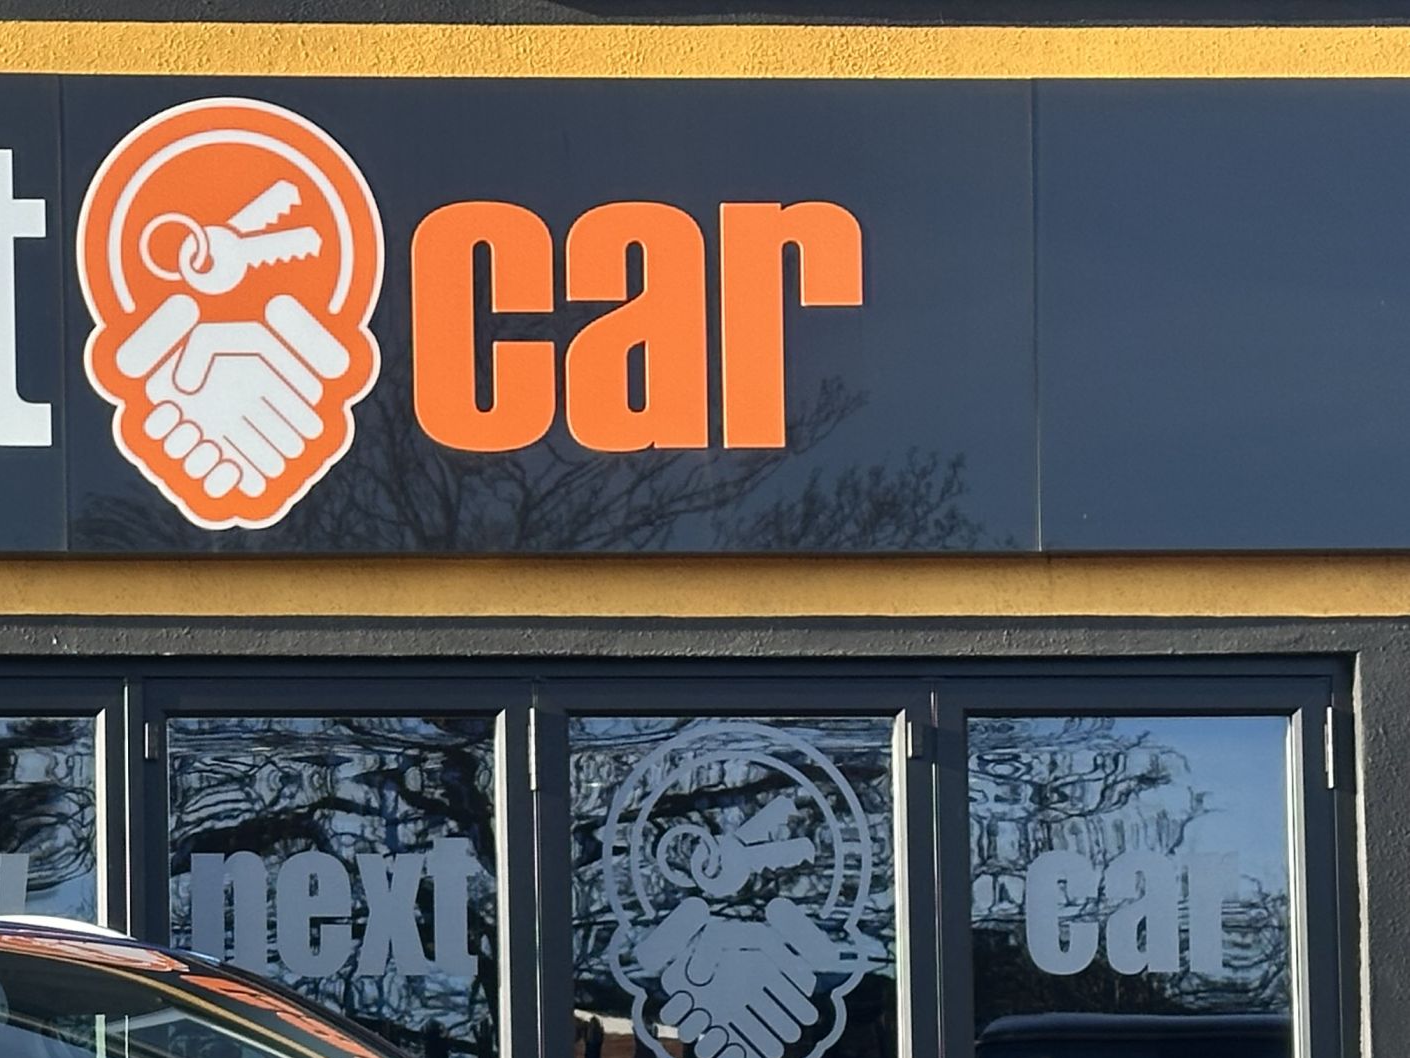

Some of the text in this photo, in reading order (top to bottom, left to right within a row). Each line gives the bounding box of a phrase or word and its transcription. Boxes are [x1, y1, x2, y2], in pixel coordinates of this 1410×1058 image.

[410, 200, 864, 451] car
[190, 837, 478, 977] next
[1027, 850, 1238, 976] car
